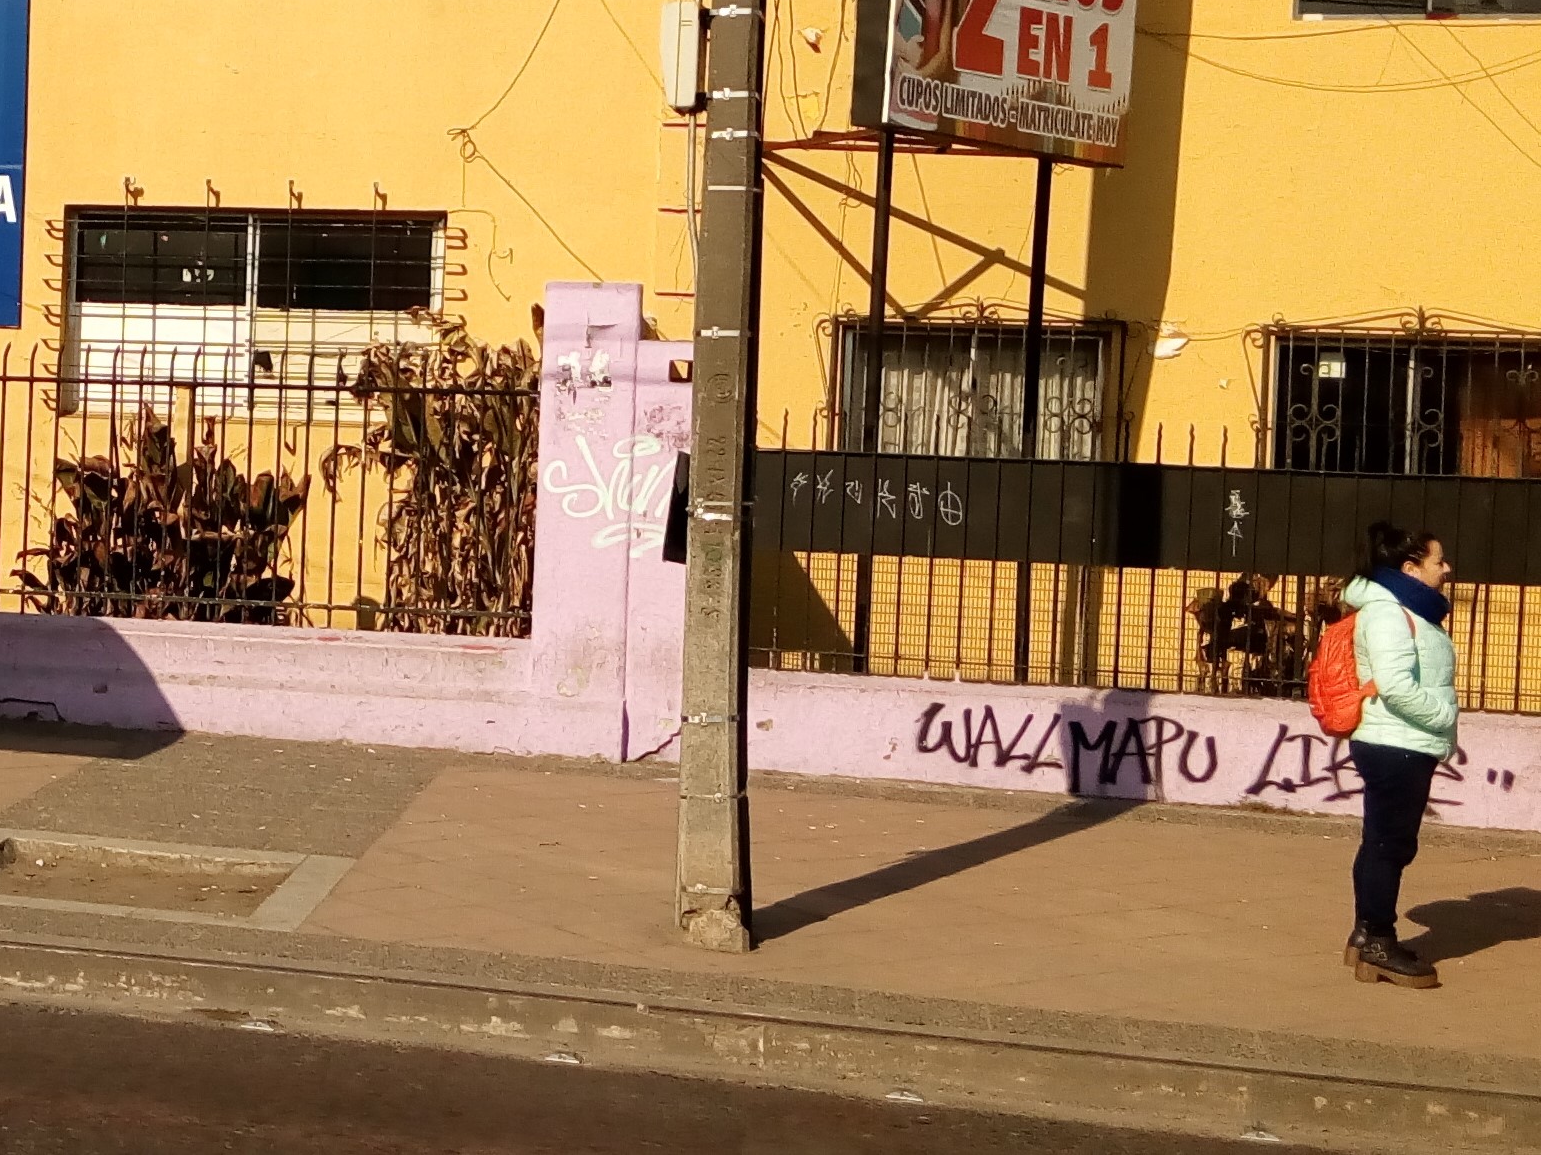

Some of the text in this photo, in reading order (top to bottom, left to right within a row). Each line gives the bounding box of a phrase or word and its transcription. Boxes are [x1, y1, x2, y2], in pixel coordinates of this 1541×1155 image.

[1016, 6, 1113, 92] EN 1
[898, 75, 941, 115] CUPOS
[942, 82, 1009, 128] LIMITADOS
[1018, 98, 1094, 144] MATRICULATE
[1095, 113, 1119, 147] HOY
